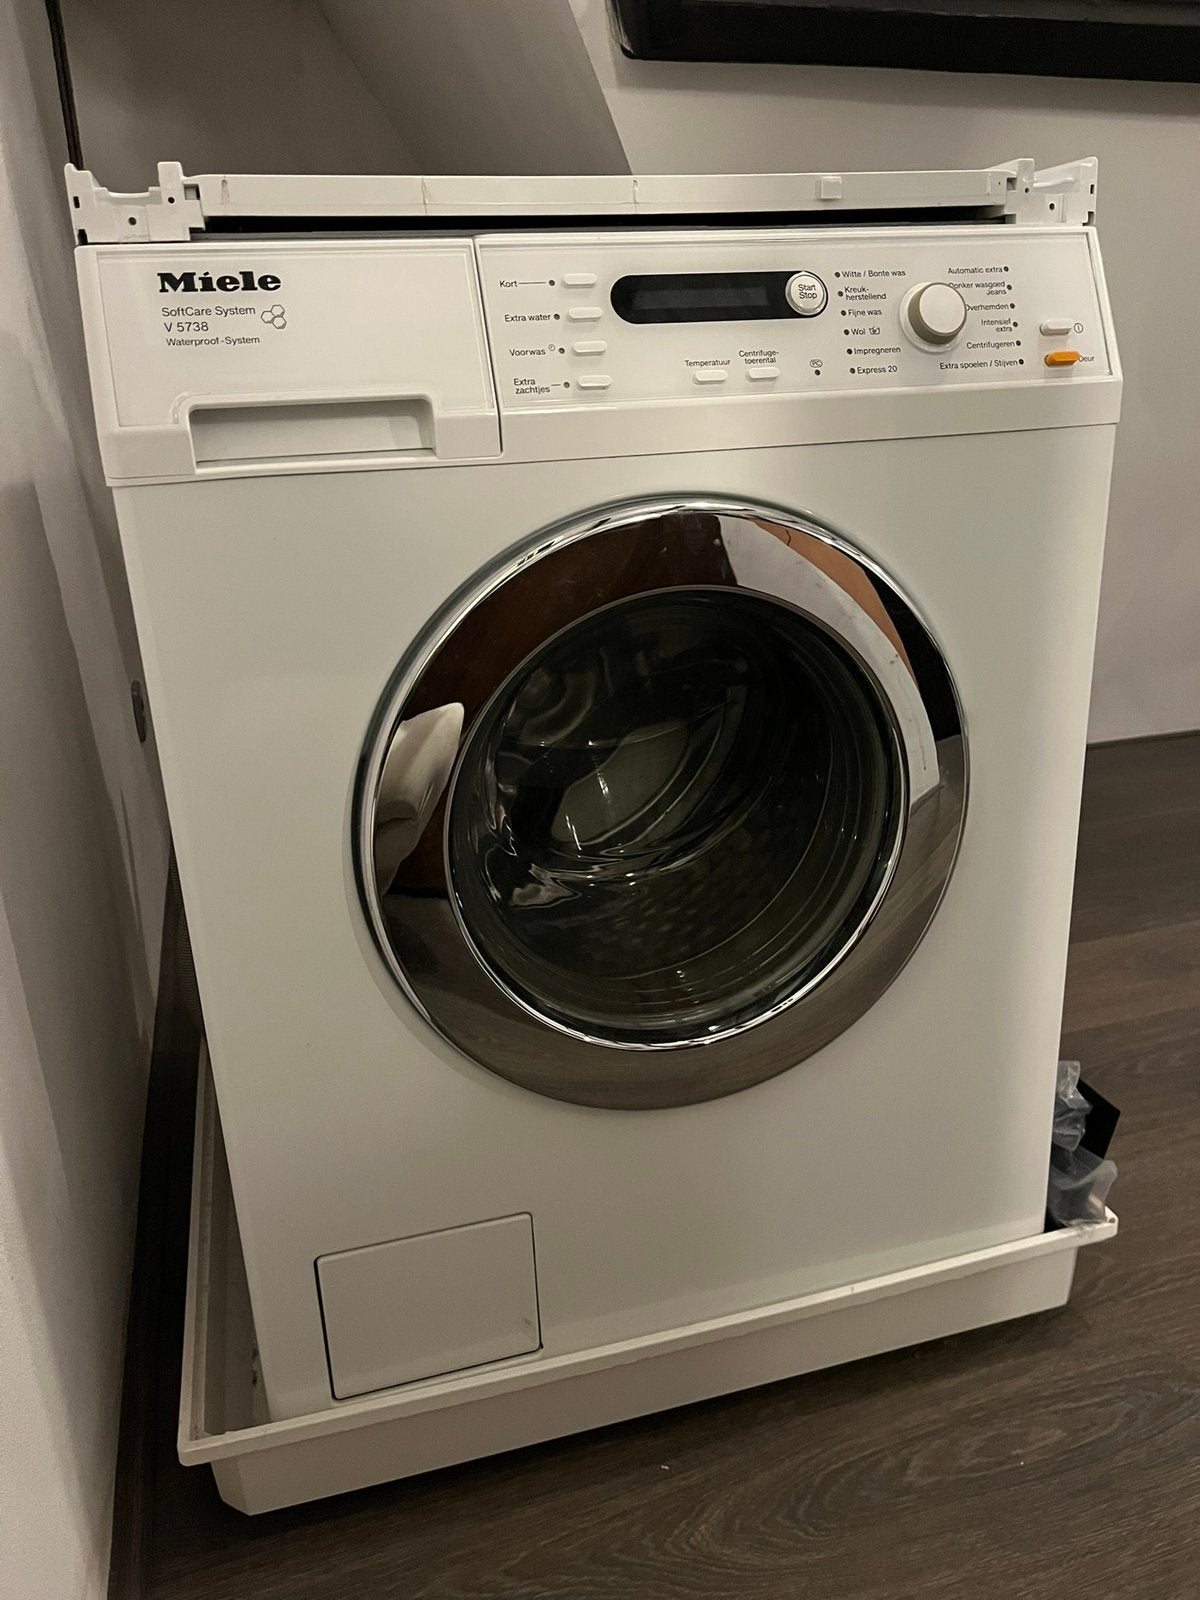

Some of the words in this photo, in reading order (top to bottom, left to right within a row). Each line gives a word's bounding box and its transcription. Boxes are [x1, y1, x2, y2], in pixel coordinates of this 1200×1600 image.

[841, 270, 861, 278] Witte
[157, 271, 281, 293] Miele
[499, 280, 518, 288] Kort
[975, 281, 1005, 289] wasgoed
[799, 291, 817, 299] Stop
[846, 293, 887, 301] herstellend
[161, 306, 212, 317] SoftCare
[215, 306, 256, 317] System
[848, 309, 866, 317] Fijne
[504, 314, 527, 322] Extra
[981, 318, 1011, 326] Intensief
[163, 322, 173, 332] V
[177, 321, 209, 332] 5738
[966, 340, 1015, 350] Centrifugeren
[509, 348, 546, 356] Voorwas
[738, 350, 779, 358] Centrifuge-
[854, 346, 901, 355] Impregneren
[684, 359, 731, 368] Temperatuur
[744, 356, 776, 364] toerental
[939, 362, 959, 370] Extra
[960, 361, 988, 369] spoelen
[857, 366, 886, 375] Express
[888, 365, 898, 373] 20
[513, 378, 536, 386] Extra
[515, 386, 551, 395] zachtjes
